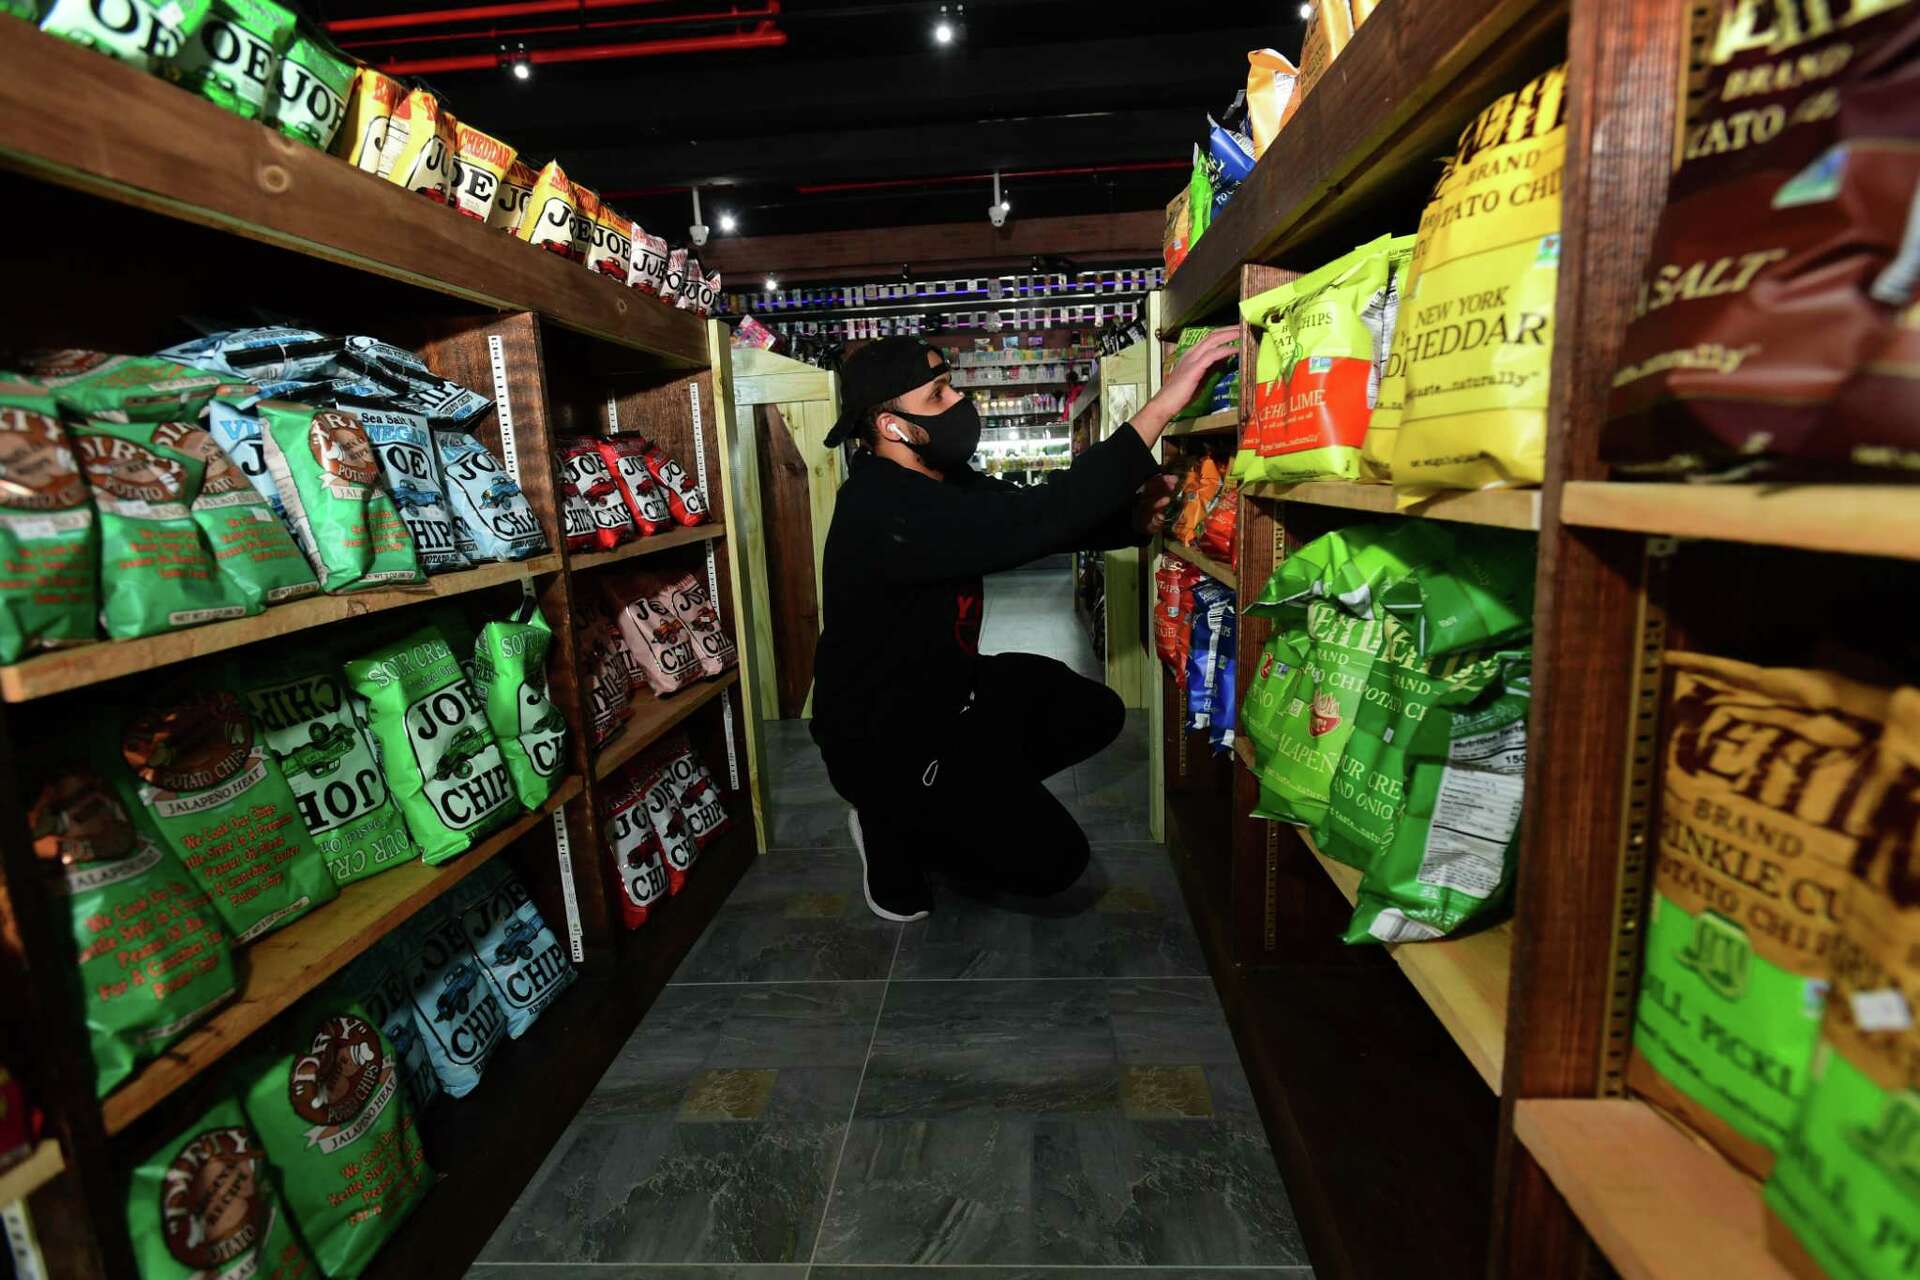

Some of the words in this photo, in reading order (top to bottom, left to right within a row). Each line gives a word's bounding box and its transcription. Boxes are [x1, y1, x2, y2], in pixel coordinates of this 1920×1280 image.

[1466, 149, 1542, 187] BRAND
[1415, 301, 1455, 329] NEW
[1459, 285, 1511, 316] YORK
[1405, 312, 1548, 364] HEDDAR
[362, 412, 383, 424] Sea
[386, 414, 406, 426] Salt
[1290, 389, 1326, 412] LIME
[367, 645, 414, 688] SOUR
[231, 767, 262, 794] HEAT
[440, 762, 511, 824] CHIP
[1694, 800, 1804, 858] BRAND
[506, 943, 563, 1003] CHIP
